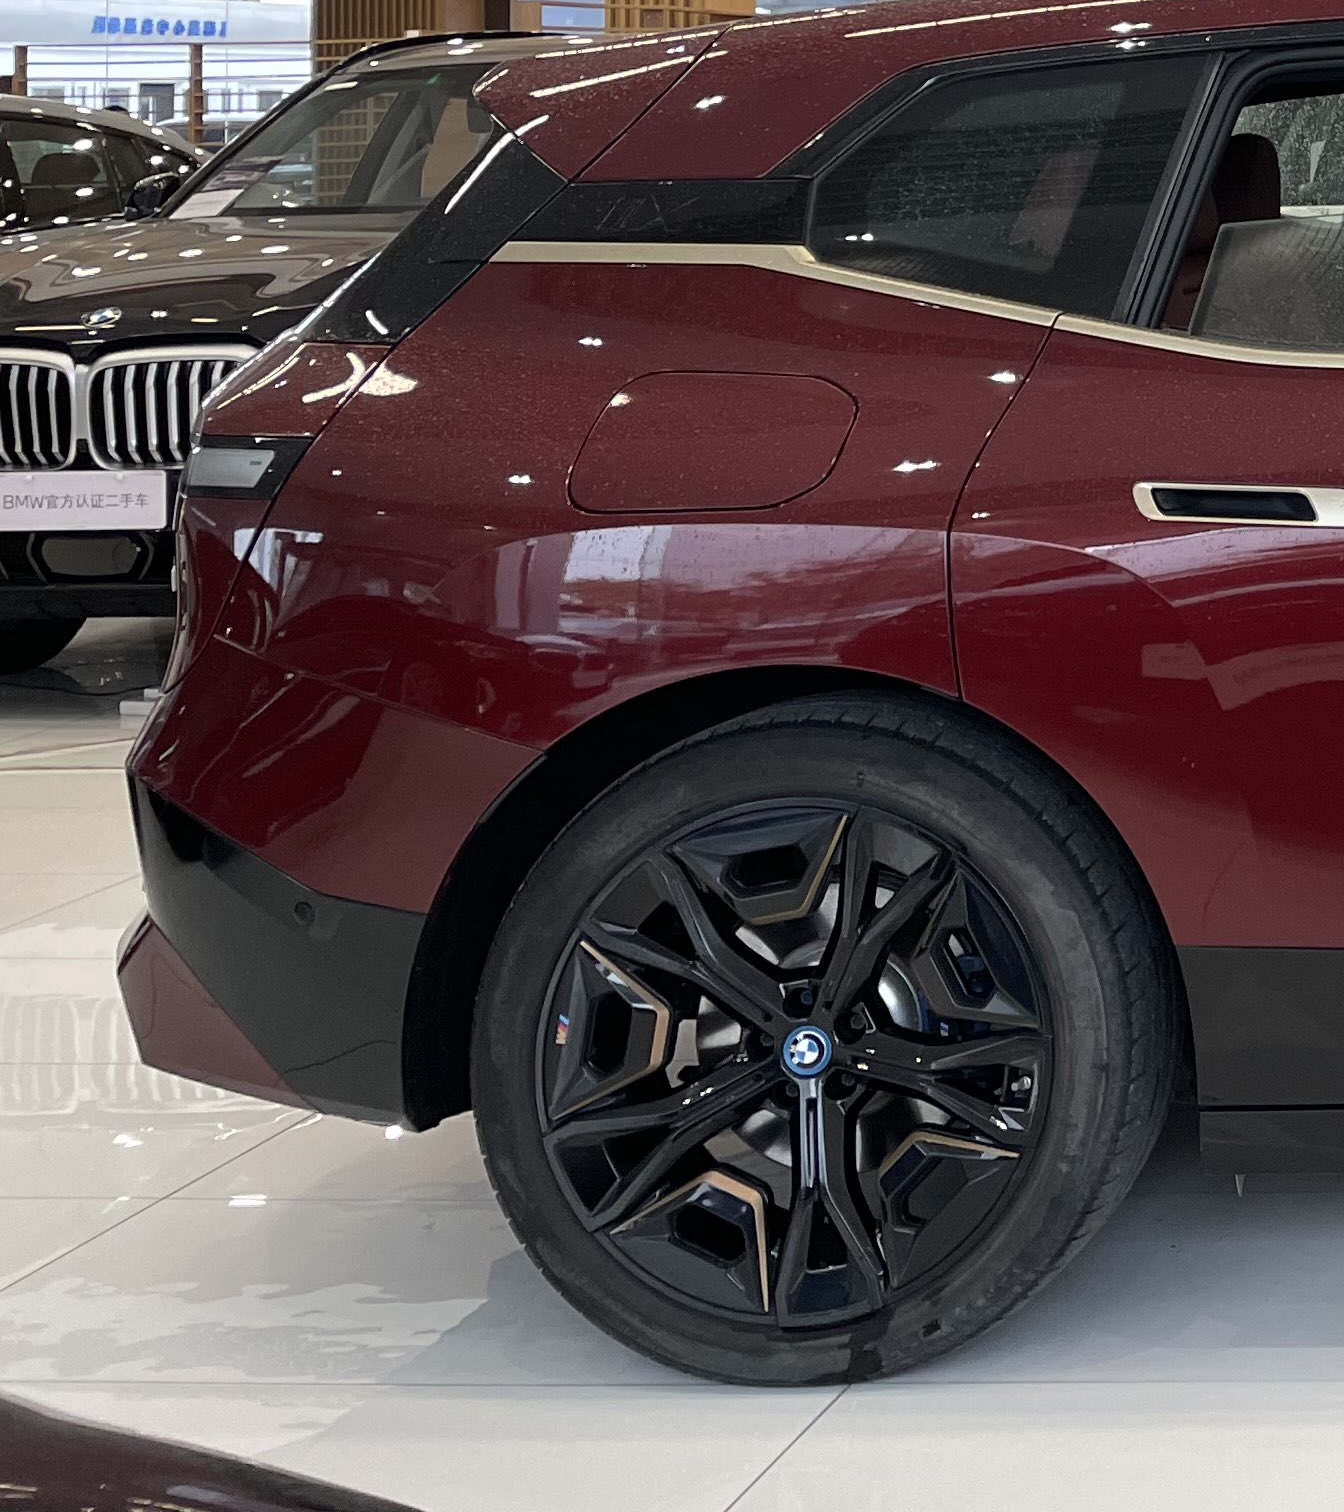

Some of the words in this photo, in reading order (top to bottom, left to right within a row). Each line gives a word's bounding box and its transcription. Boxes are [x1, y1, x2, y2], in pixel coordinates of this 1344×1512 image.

[3, 492, 149, 509] BMW官方认证二手车
